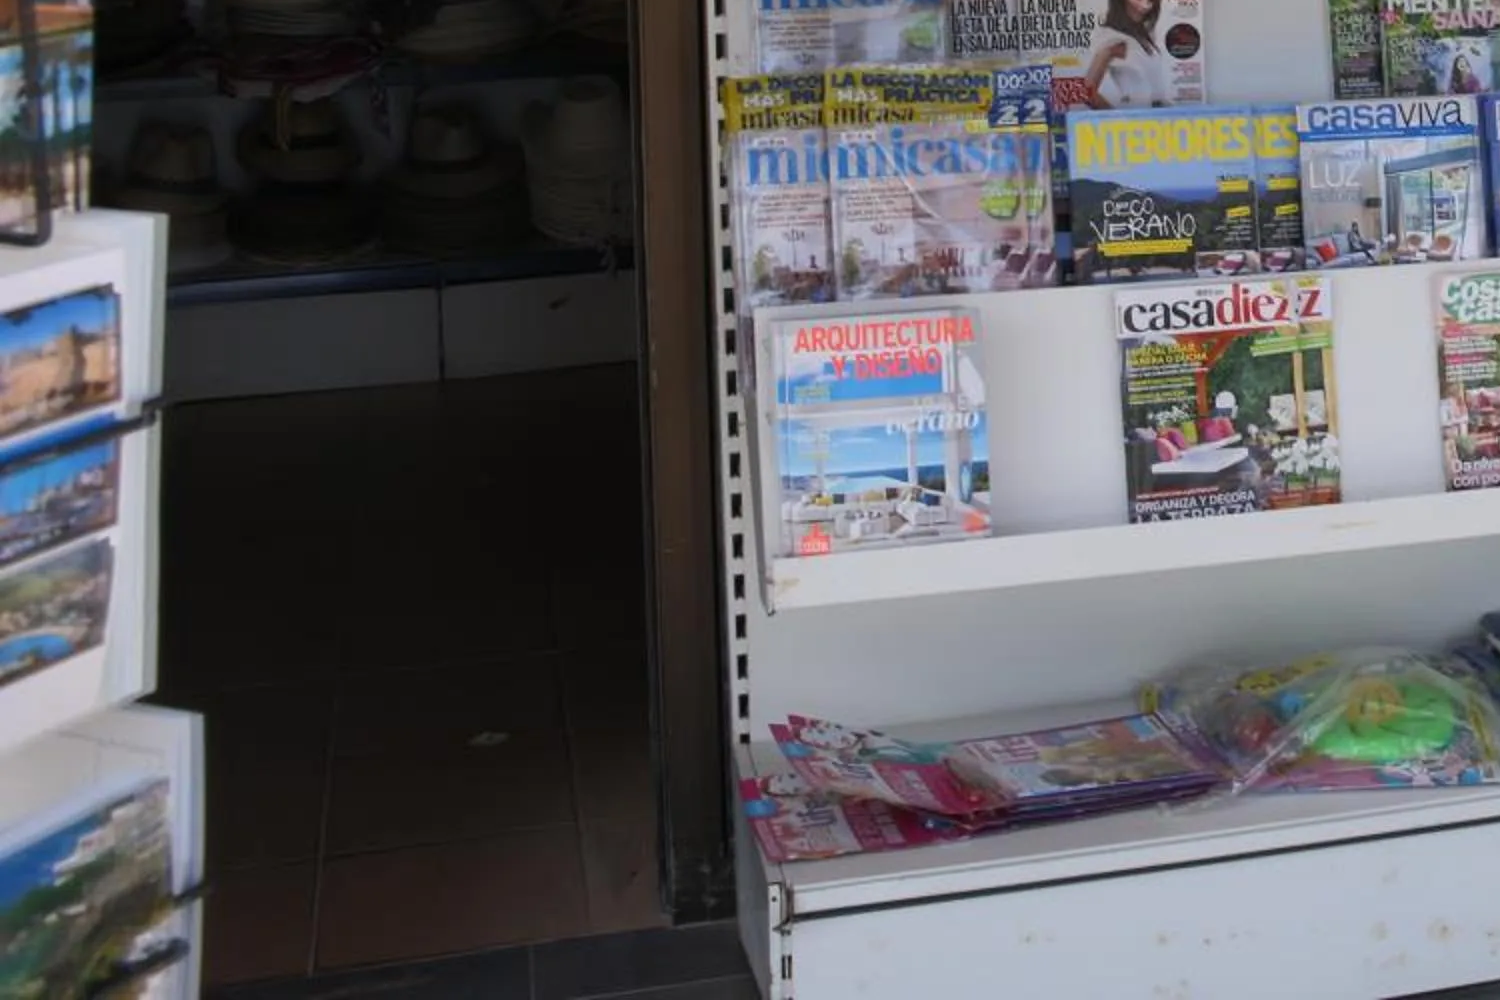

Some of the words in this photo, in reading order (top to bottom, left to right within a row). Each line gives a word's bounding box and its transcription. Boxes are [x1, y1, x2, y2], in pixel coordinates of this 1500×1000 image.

[969, 0, 1007, 15] NUEVA
[1021, 15, 1054, 32] DIETA
[1057, 14, 1074, 30] DE
[1077, 12, 1095, 29] LAS
[1022, 30, 1092, 49] ENSALADAS
[997, 104, 1020, 125] 2
[1023, 98, 1046, 123] 2
[1075, 118, 1250, 170] INTERIORES
[1309, 157, 1361, 190] LUZ
[1103, 198, 1155, 217] DECO
[1090, 211, 1198, 242] VERANO
[1123, 283, 1291, 333] casadiez
[793, 316, 975, 353] ARQUITECTURA
[832, 356, 848, 379] Y
[855, 346, 942, 381] DISEÑO
[1135, 499, 1197, 514] ORGANIZA
[1208, 492, 1255, 505] DECORA
